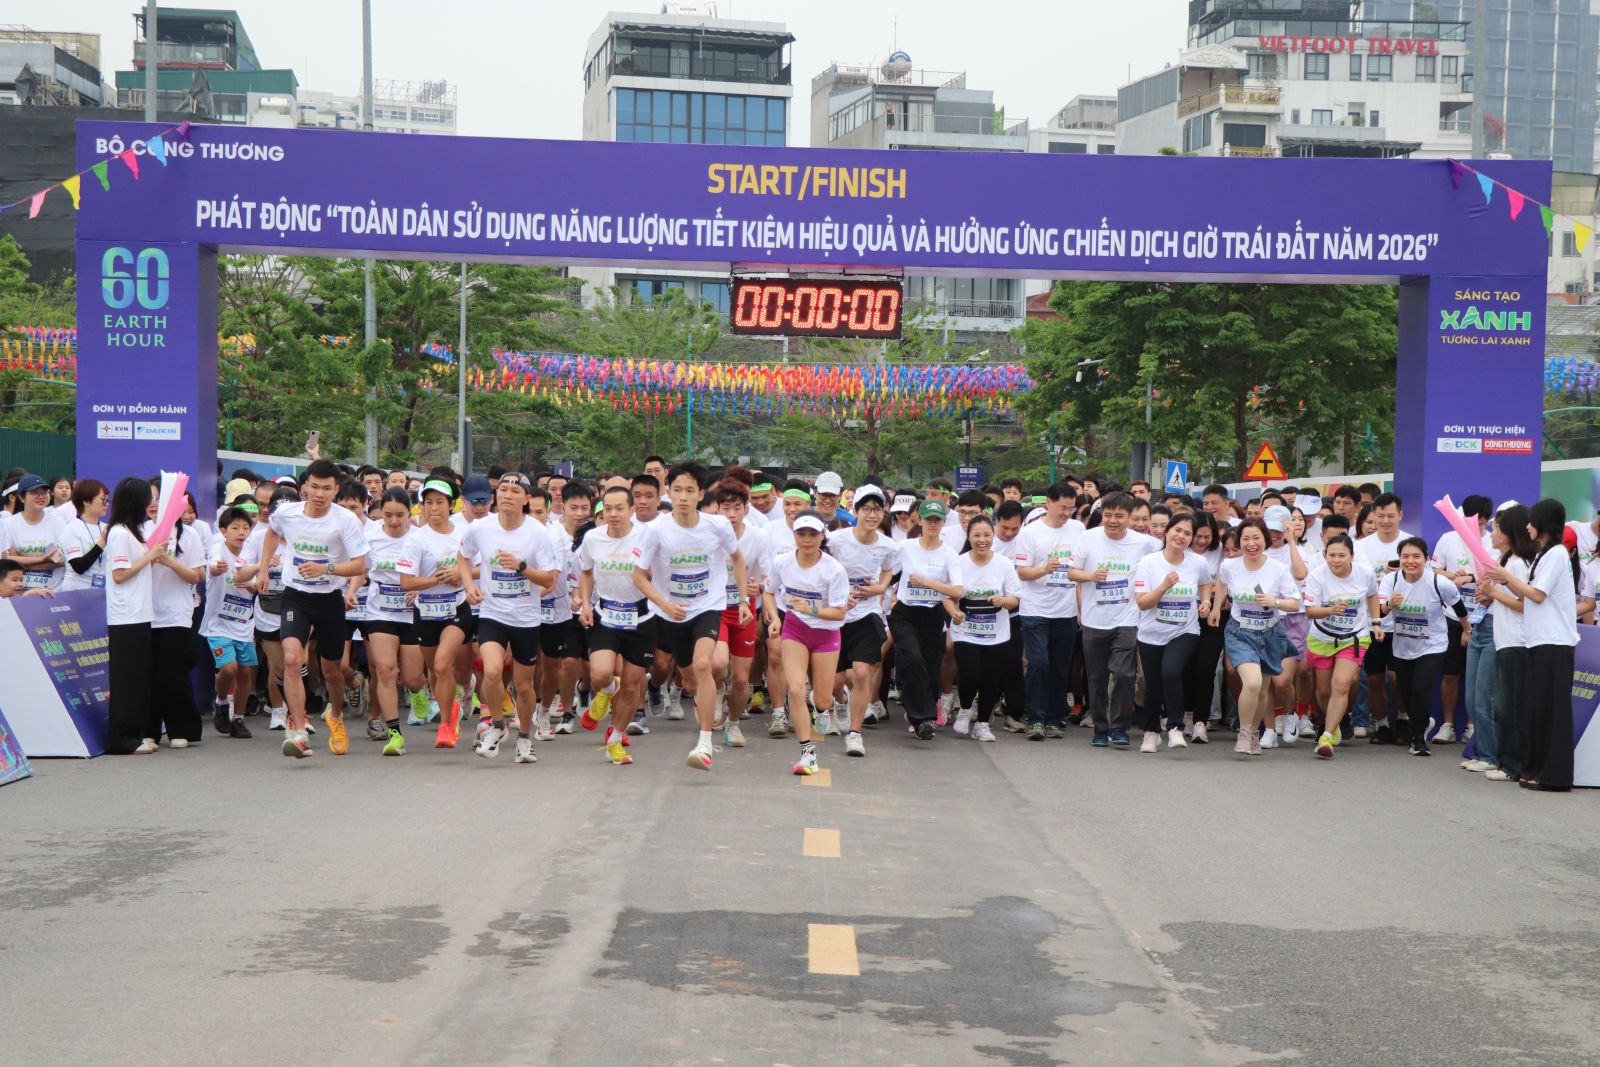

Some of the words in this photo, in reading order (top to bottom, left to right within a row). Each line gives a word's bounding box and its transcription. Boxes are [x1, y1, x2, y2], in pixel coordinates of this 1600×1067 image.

[1258, 34, 1357, 54] VIETFOOT
[1368, 37, 1440, 55] TRAVEL
[96, 135, 124, 159] BỘ
[200, 142, 285, 162] THƯƠNG
[707, 163, 906, 200] START/FINISH
[196, 194, 257, 229] PHÁT
[260, 196, 321, 237] ĐỘNG
[403, 202, 449, 237] DÂN
[453, 201, 483, 239] SỬ
[486, 210, 546, 246] DỤNG
[551, 208, 612, 243] NĂNG
[617, 212, 688, 251] LƯỢNG
[693, 207, 738, 247] TIẾT
[742, 214, 794, 255] KIỆM
[800, 216, 848, 256] HIỆU
[852, 215, 897, 257] QUẢ
[901, 217, 930, 253] VÀ
[935, 216, 1009, 255] HƯỞNG
[1014, 220, 1058, 256] ỨNG
[1063, 217, 1125, 257] CHIẾN
[1131, 230, 1178, 264] DỊCH
[1183, 223, 1218, 259] GIỜ
[1222, 224, 1271, 259] TRÁI
[1276, 219, 1319, 260] ĐẤT
[1323, 226, 1373, 260] NĂM
[102, 247, 170, 309] 60
[1455, 288, 1490, 301] SÁNG
[1494, 291, 1521, 304] TẠO
[735, 285, 899, 331] 00:00:00
[104, 314, 167, 329] EARTH
[1440, 306, 1532, 331] XANH
[107, 333, 166, 347] HOUR
[1441, 335, 1478, 345] TƯƠNG
[1481, 337, 1498, 345] LAI
[1500, 337, 1531, 345] XANH
[92, 403, 114, 413] ĐƠN
[116, 405, 126, 415] VỊ
[129, 402, 157, 414] ĐỒNG
[160, 404, 187, 414] HÀNH
[1444, 425, 1465, 433] ĐƠN
[1478, 425, 1502, 436] THỰC
[1504, 425, 1525, 436] HIỆN
[498, 581, 525, 590] 3.259
[608, 611, 633, 621] 3.632
